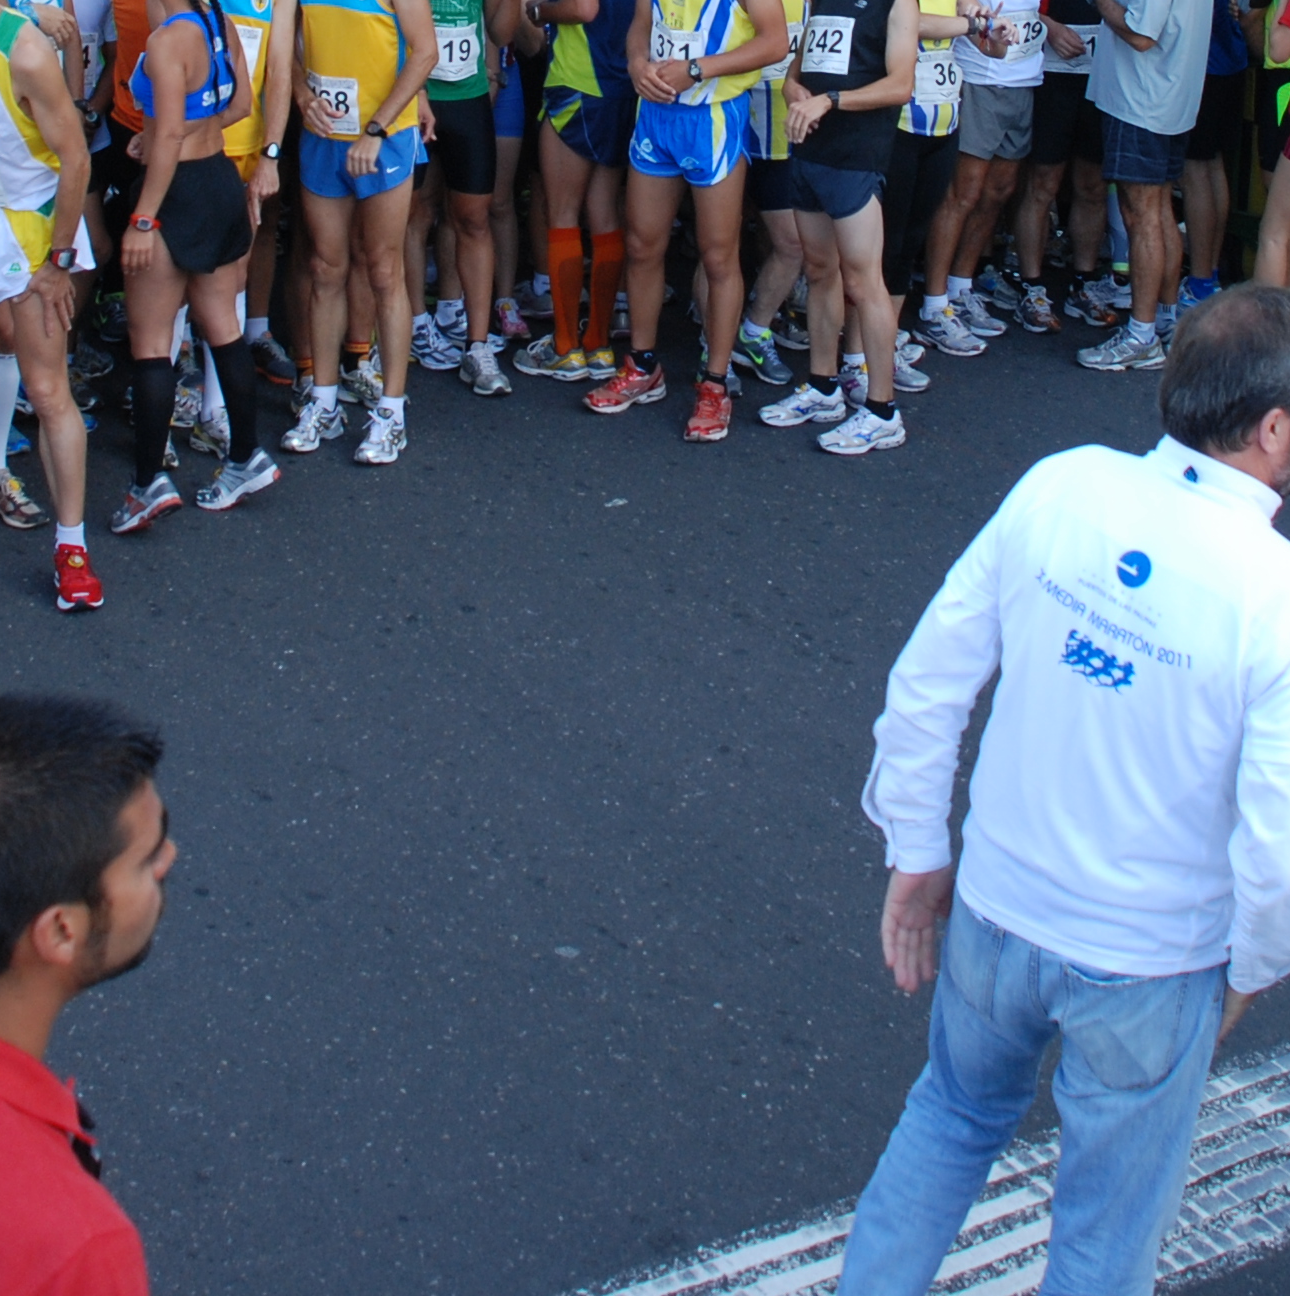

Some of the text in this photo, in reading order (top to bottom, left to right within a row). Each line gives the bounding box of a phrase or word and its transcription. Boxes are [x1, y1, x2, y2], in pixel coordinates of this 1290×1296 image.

[807, 29, 844, 54] 242
[1014, 20, 1043, 44] 29
[933, 62, 957, 86] 36
[312, 85, 350, 115] 68
[1042, 579, 1087, 618] MEDIA
[1157, 646, 1193, 671] 2011
